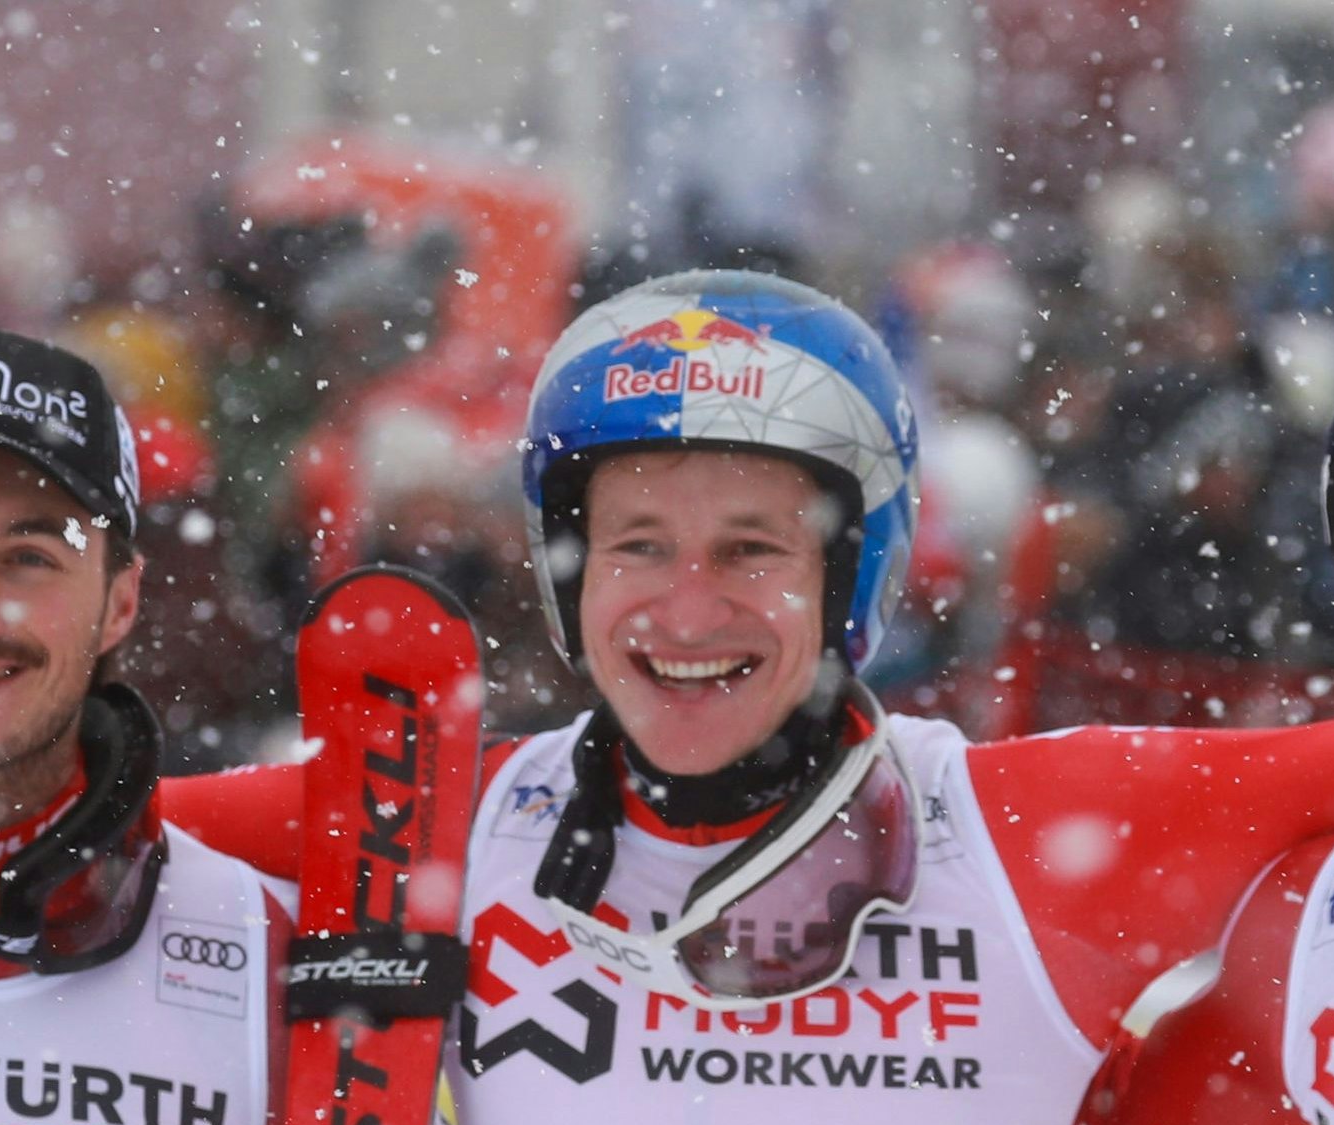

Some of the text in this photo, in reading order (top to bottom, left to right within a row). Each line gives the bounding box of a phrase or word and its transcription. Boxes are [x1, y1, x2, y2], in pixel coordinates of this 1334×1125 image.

[605, 357, 764, 400] Red Bull
[288, 957, 429, 985] STÖCKLI
[641, 1046, 982, 1089] WORKWEAR
